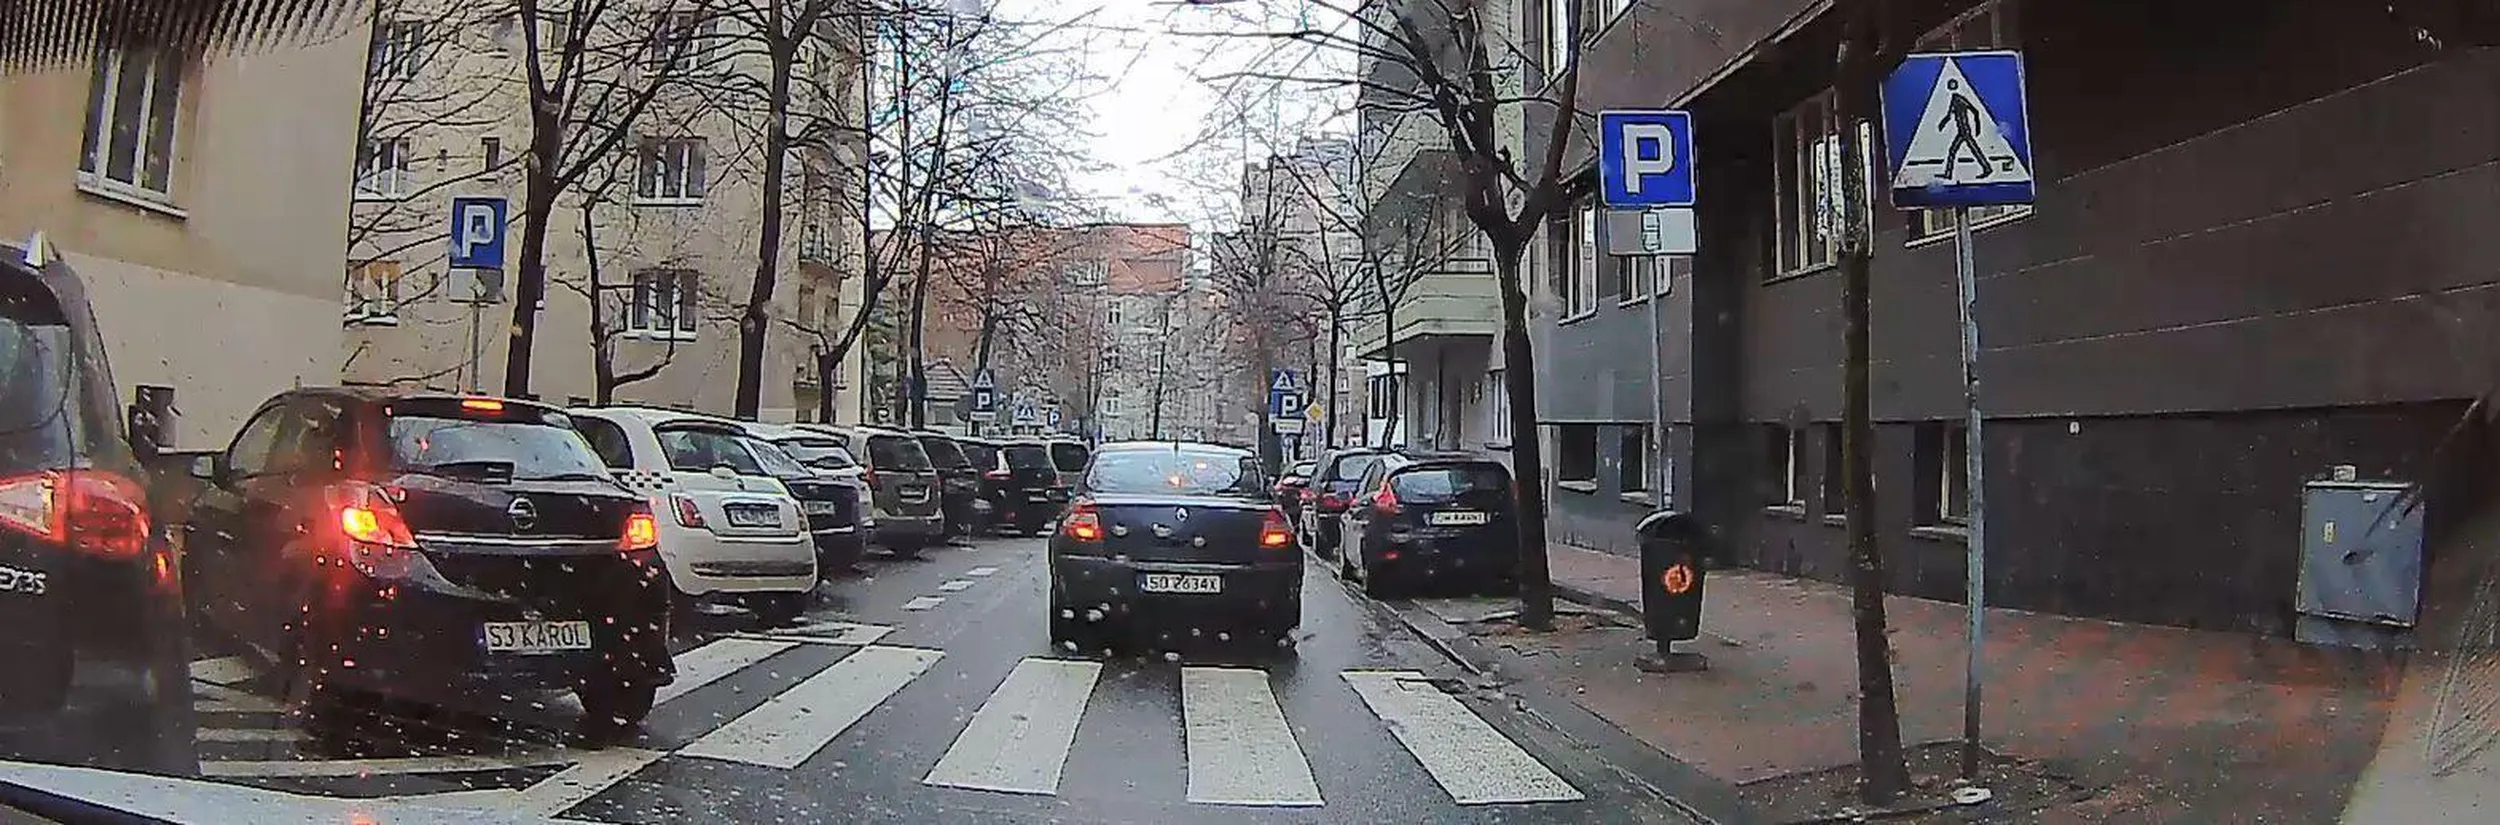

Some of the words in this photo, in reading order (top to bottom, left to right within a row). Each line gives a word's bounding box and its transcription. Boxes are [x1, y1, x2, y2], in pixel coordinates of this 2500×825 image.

[1622, 124, 1675, 194] P
[462, 205, 495, 258] P
[977, 392, 990, 410] P
[1281, 395, 1298, 418] P
[488, 624, 515, 647] S3
[521, 623, 587, 648] KAROL
